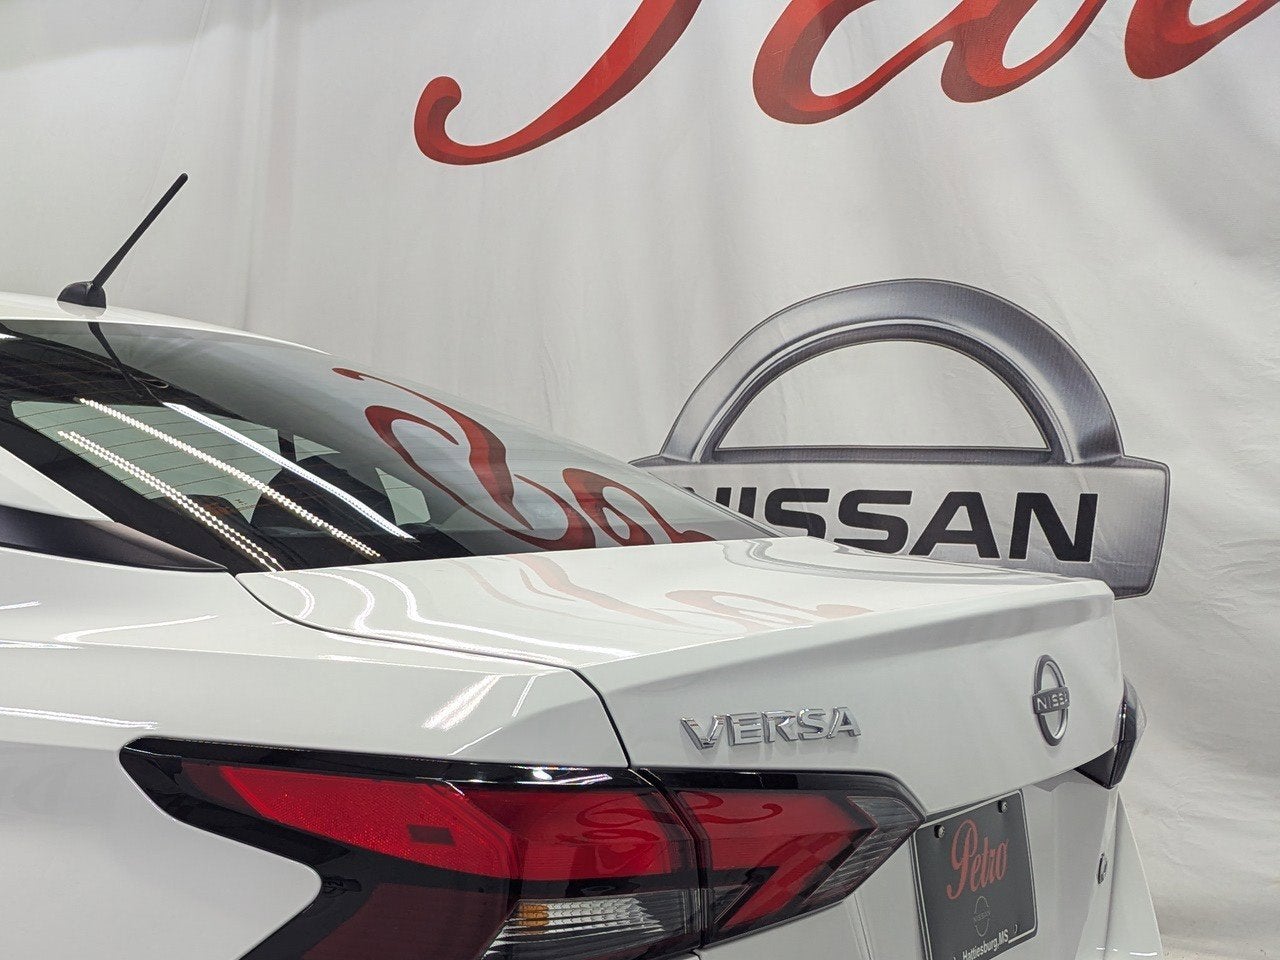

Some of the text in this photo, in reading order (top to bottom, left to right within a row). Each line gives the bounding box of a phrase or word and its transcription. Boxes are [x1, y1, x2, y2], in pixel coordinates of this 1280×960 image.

[683, 486, 1099, 563] SSAN
[680, 706, 861, 750] VERSA
[1036, 690, 1069, 711] NISS
[946, 819, 1009, 900] Petro
